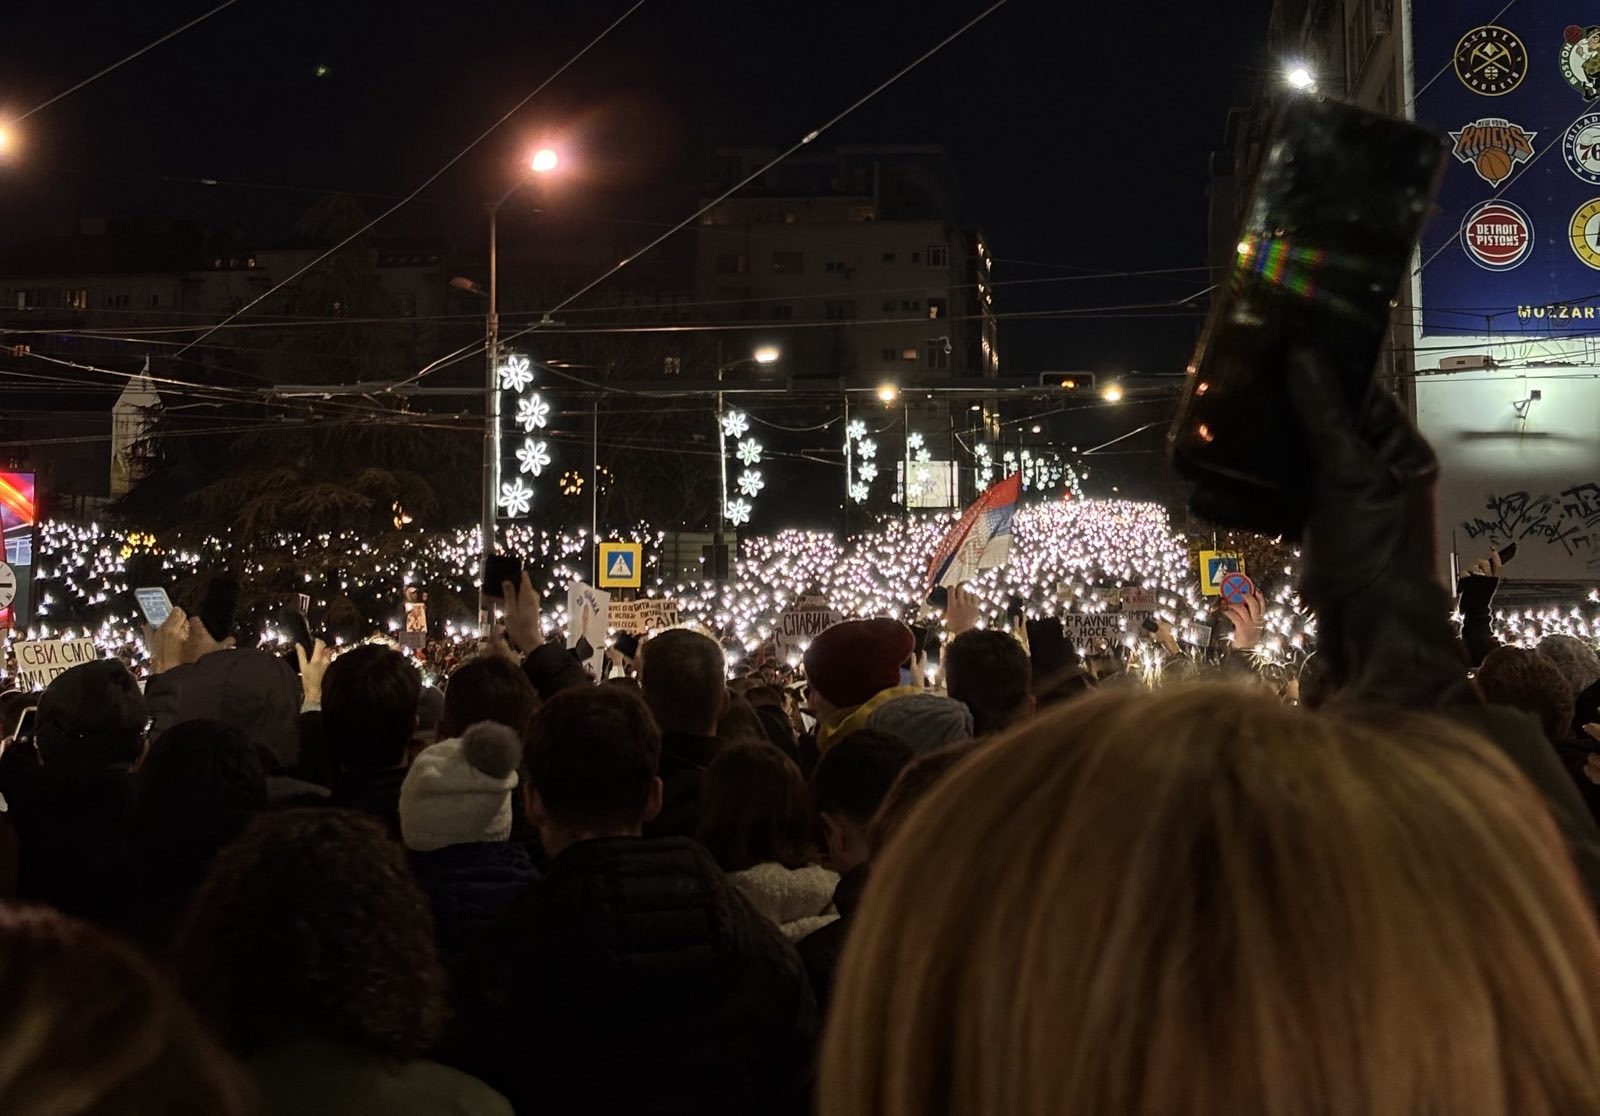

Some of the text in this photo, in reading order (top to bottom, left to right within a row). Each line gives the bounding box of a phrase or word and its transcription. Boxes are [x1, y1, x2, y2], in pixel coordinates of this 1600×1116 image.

[1463, 30, 1517, 49] DENVER
[1560, 42, 1578, 86] BOSTON
[1463, 71, 1520, 92] NUGGETS
[1477, 119, 1508, 127] NEW YORK
[1455, 126, 1532, 156] KNICKS
[1475, 223, 1519, 235] DETROIT
[1475, 235, 1519, 246] PISTONS
[1066, 615, 1118, 627] PRAVNICI
[22, 642, 95, 665] СВИ СМО
